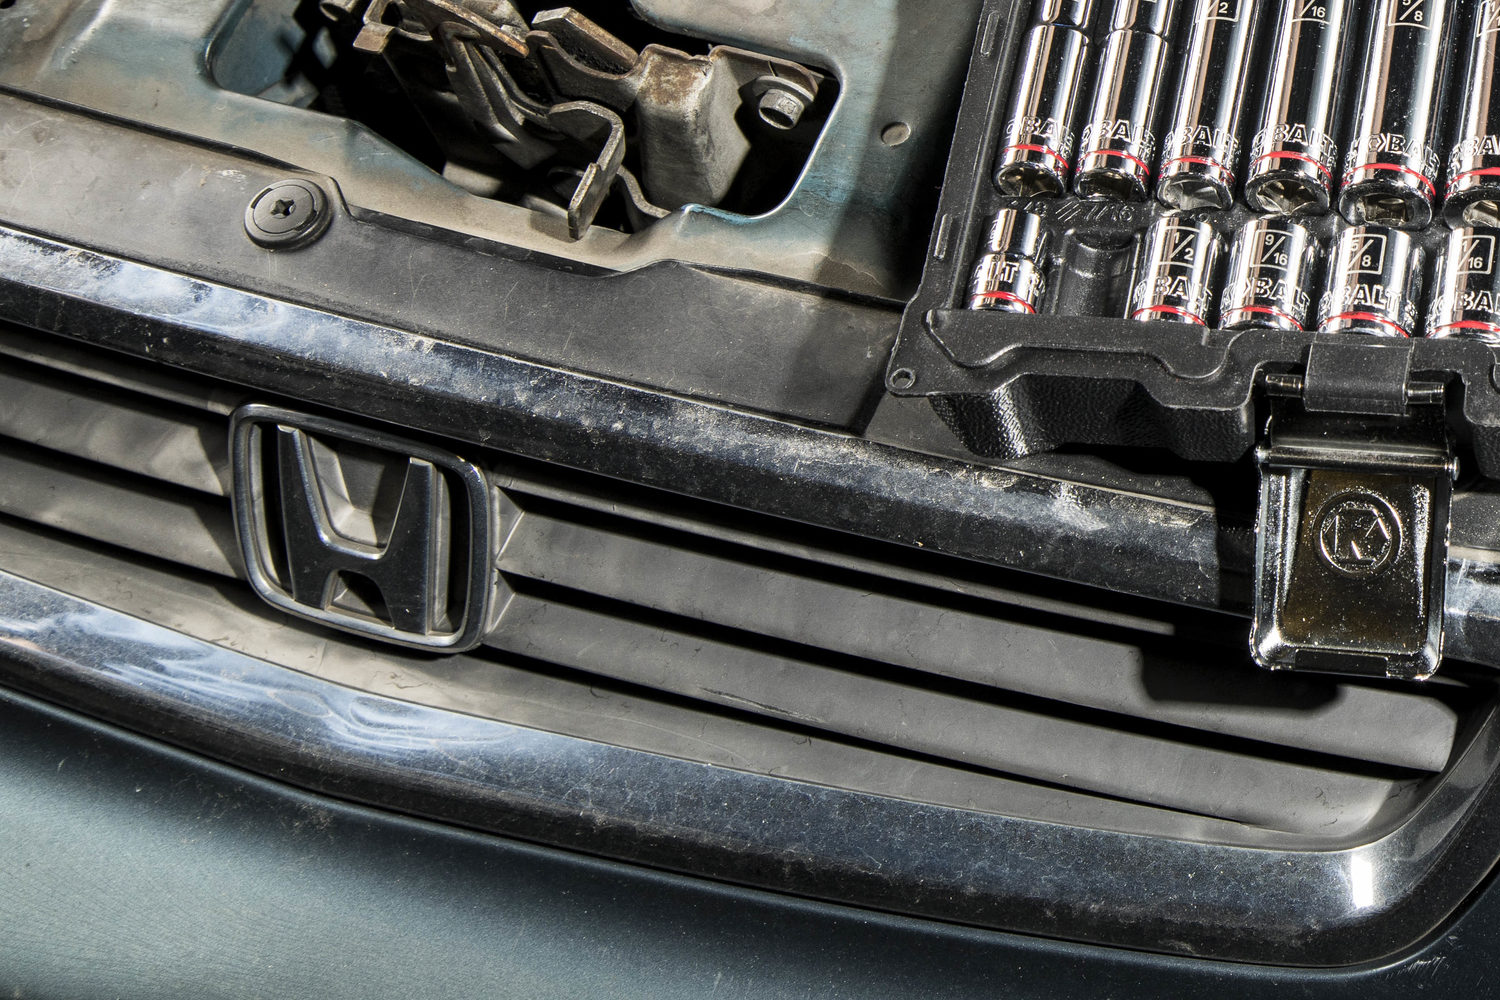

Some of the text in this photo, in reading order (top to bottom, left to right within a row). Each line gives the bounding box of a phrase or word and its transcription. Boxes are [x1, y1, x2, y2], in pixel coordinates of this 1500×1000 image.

[1168, 231, 1196, 261] 1/2
[1261, 234, 1288, 266] 9/16
[1348, 237, 1374, 269] 5/8
